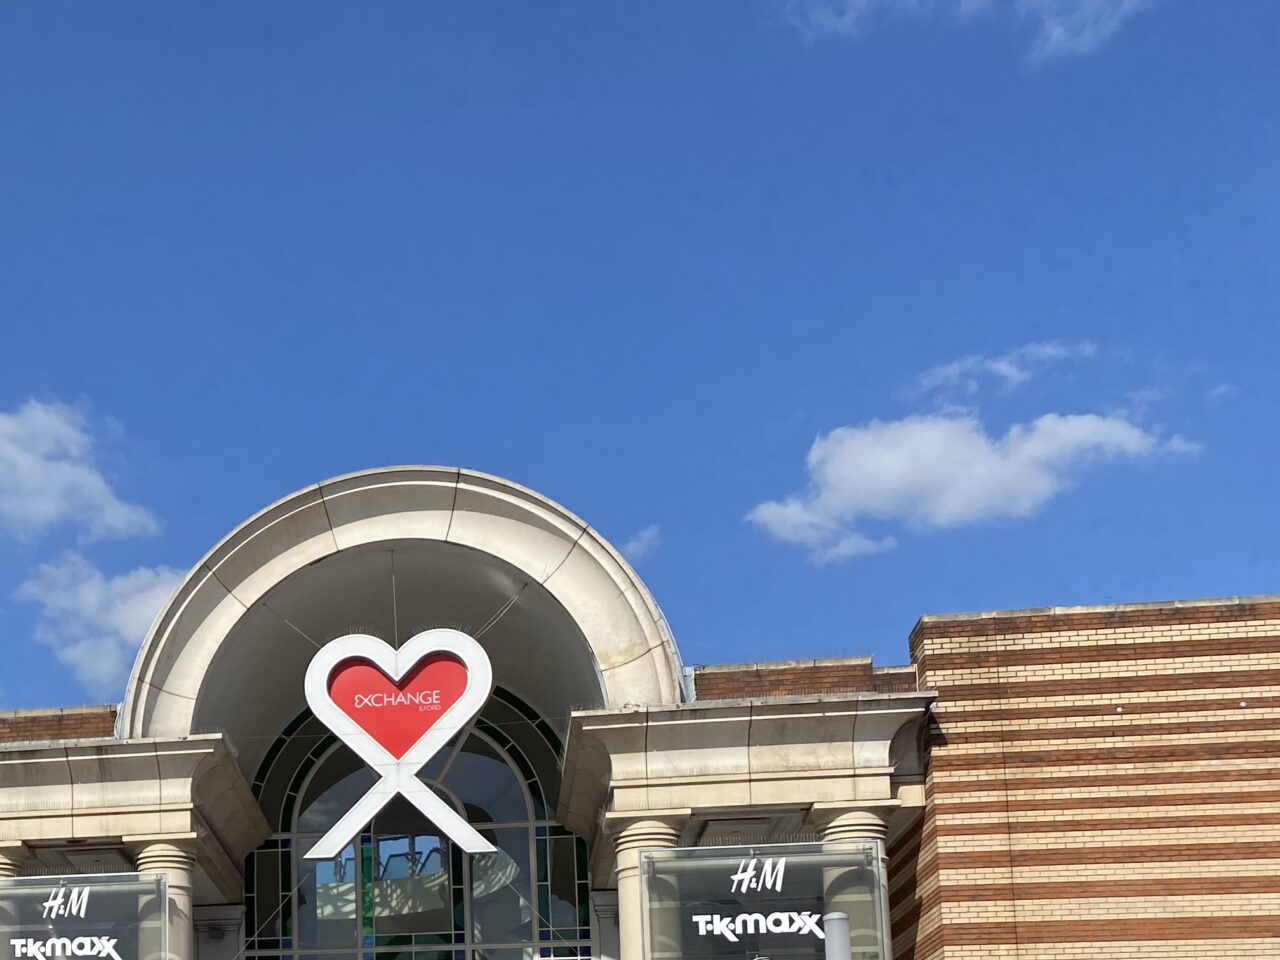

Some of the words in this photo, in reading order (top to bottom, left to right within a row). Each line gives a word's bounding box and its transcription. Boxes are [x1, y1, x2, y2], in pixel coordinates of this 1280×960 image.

[354, 690, 441, 708] EXCHANGE
[730, 857, 786, 894] H&M
[42, 886, 91, 920] H&M
